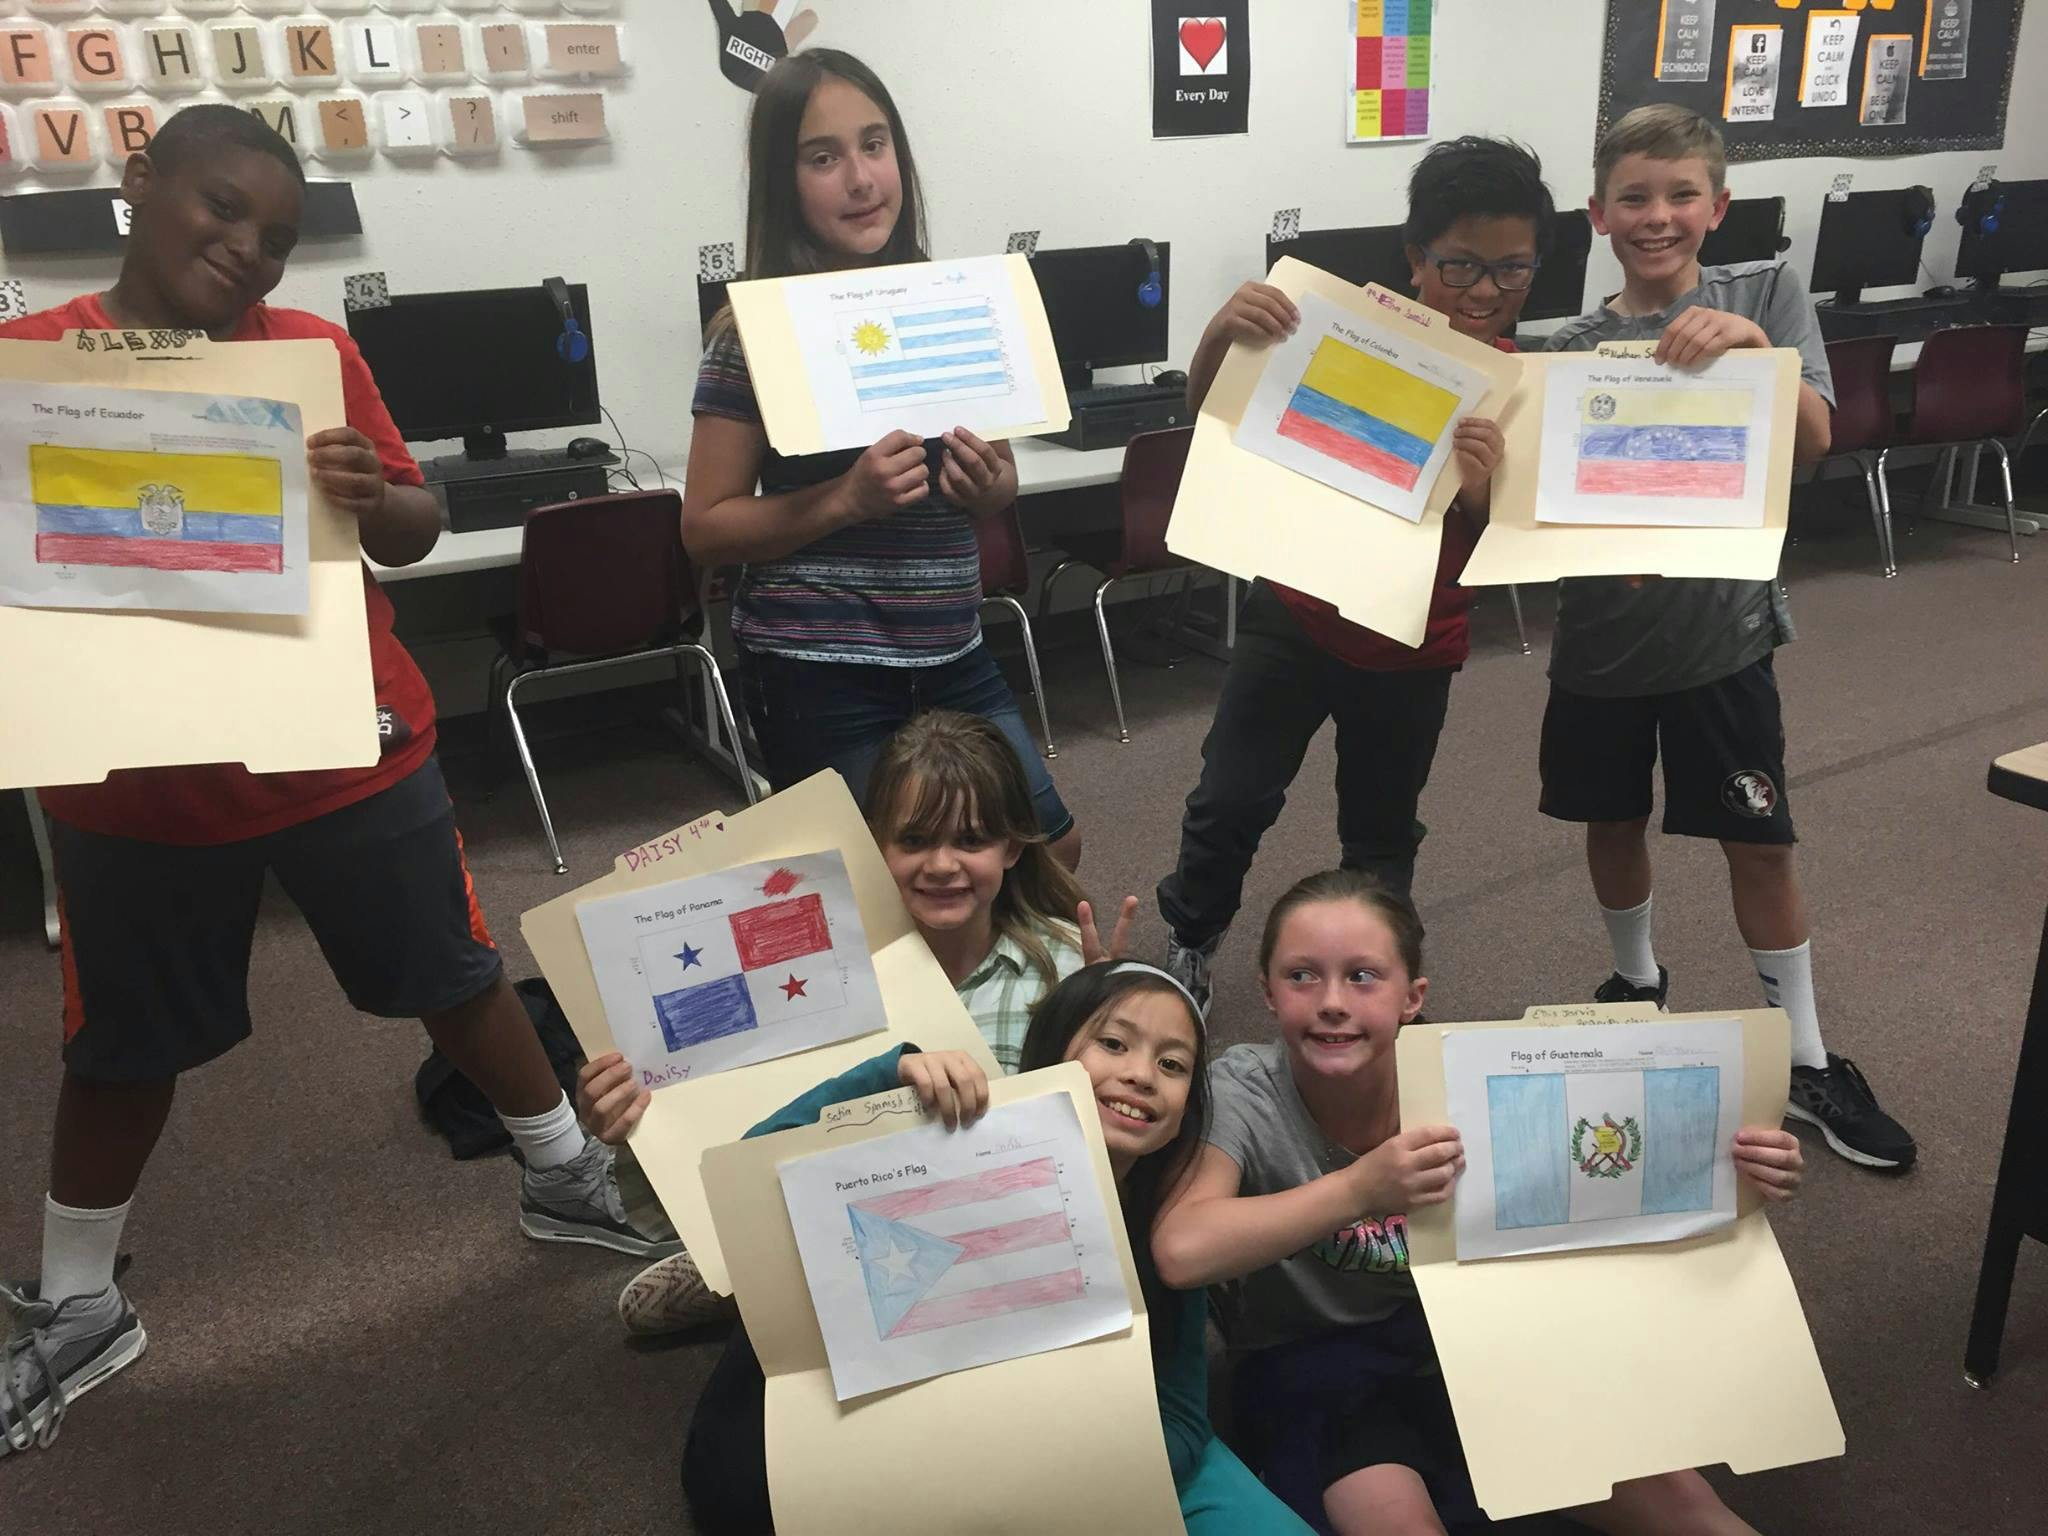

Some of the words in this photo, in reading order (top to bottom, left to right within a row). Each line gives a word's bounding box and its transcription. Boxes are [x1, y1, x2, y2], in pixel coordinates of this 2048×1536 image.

[1681, 15, 1699, 25] KEEP
[1940, 18, 1960, 29] KEEP
[1677, 29, 1699, 39] CALM
[1823, 34, 1845, 46] KEEP
[1937, 29, 1960, 39] CALM
[76, 32, 116, 75] G
[152, 33, 190, 75] H
[231, 32, 247, 74] J
[297, 30, 328, 71] K
[364, 28, 390, 67] L
[567, 43, 600, 55] enter
[729, 39, 774, 69] RIGHT
[1677, 49, 1696, 59] LOVE
[10, 34, 35, 77] F
[1746, 55, 1766, 65] KEEP
[1817, 51, 1844, 62] CALM
[1879, 59, 1900, 70] KEEP
[1743, 67, 1767, 77] CALM
[1814, 74, 1840, 87] CLICK
[1175, 89, 1206, 103] Every
[1209, 87, 1230, 102] Day
[1742, 86, 1768, 97] LOVE
[1811, 90, 1837, 103] UNDO
[551, 111, 579, 124] shift
[1731, 105, 1770, 116] INTERNET
[43, 113, 78, 155] V
[118, 110, 149, 152] B
[1281, 217, 1290, 231] 7
[1017, 238, 1028, 251] 6
[711, 254, 724, 270] 5
[359, 282, 375, 299] 4
[1332, 321, 1345, 335] The
[1588, 374, 1602, 383] The
[1604, 374, 1621, 384] Flag
[1634, 374, 1673, 383] Venezuela
[32, 403, 54, 415] The
[57, 405, 81, 419] Flag
[84, 407, 97, 418] of
[100, 409, 145, 420] Ecuador
[624, 834, 683, 872] DAISY
[634, 914, 653, 924] The
[655, 911, 675, 920] Flag
[676, 904, 687, 915] of
[689, 899, 724, 912] Panama
[1511, 1050, 1532, 1063] Flag
[1535, 1049, 1546, 1060] of
[1550, 1048, 1603, 1060] Guatemala
[835, 1178, 869, 1191] Puerto
[872, 1168, 903, 1184] Rico's
[904, 1164, 927, 1176] Flag
